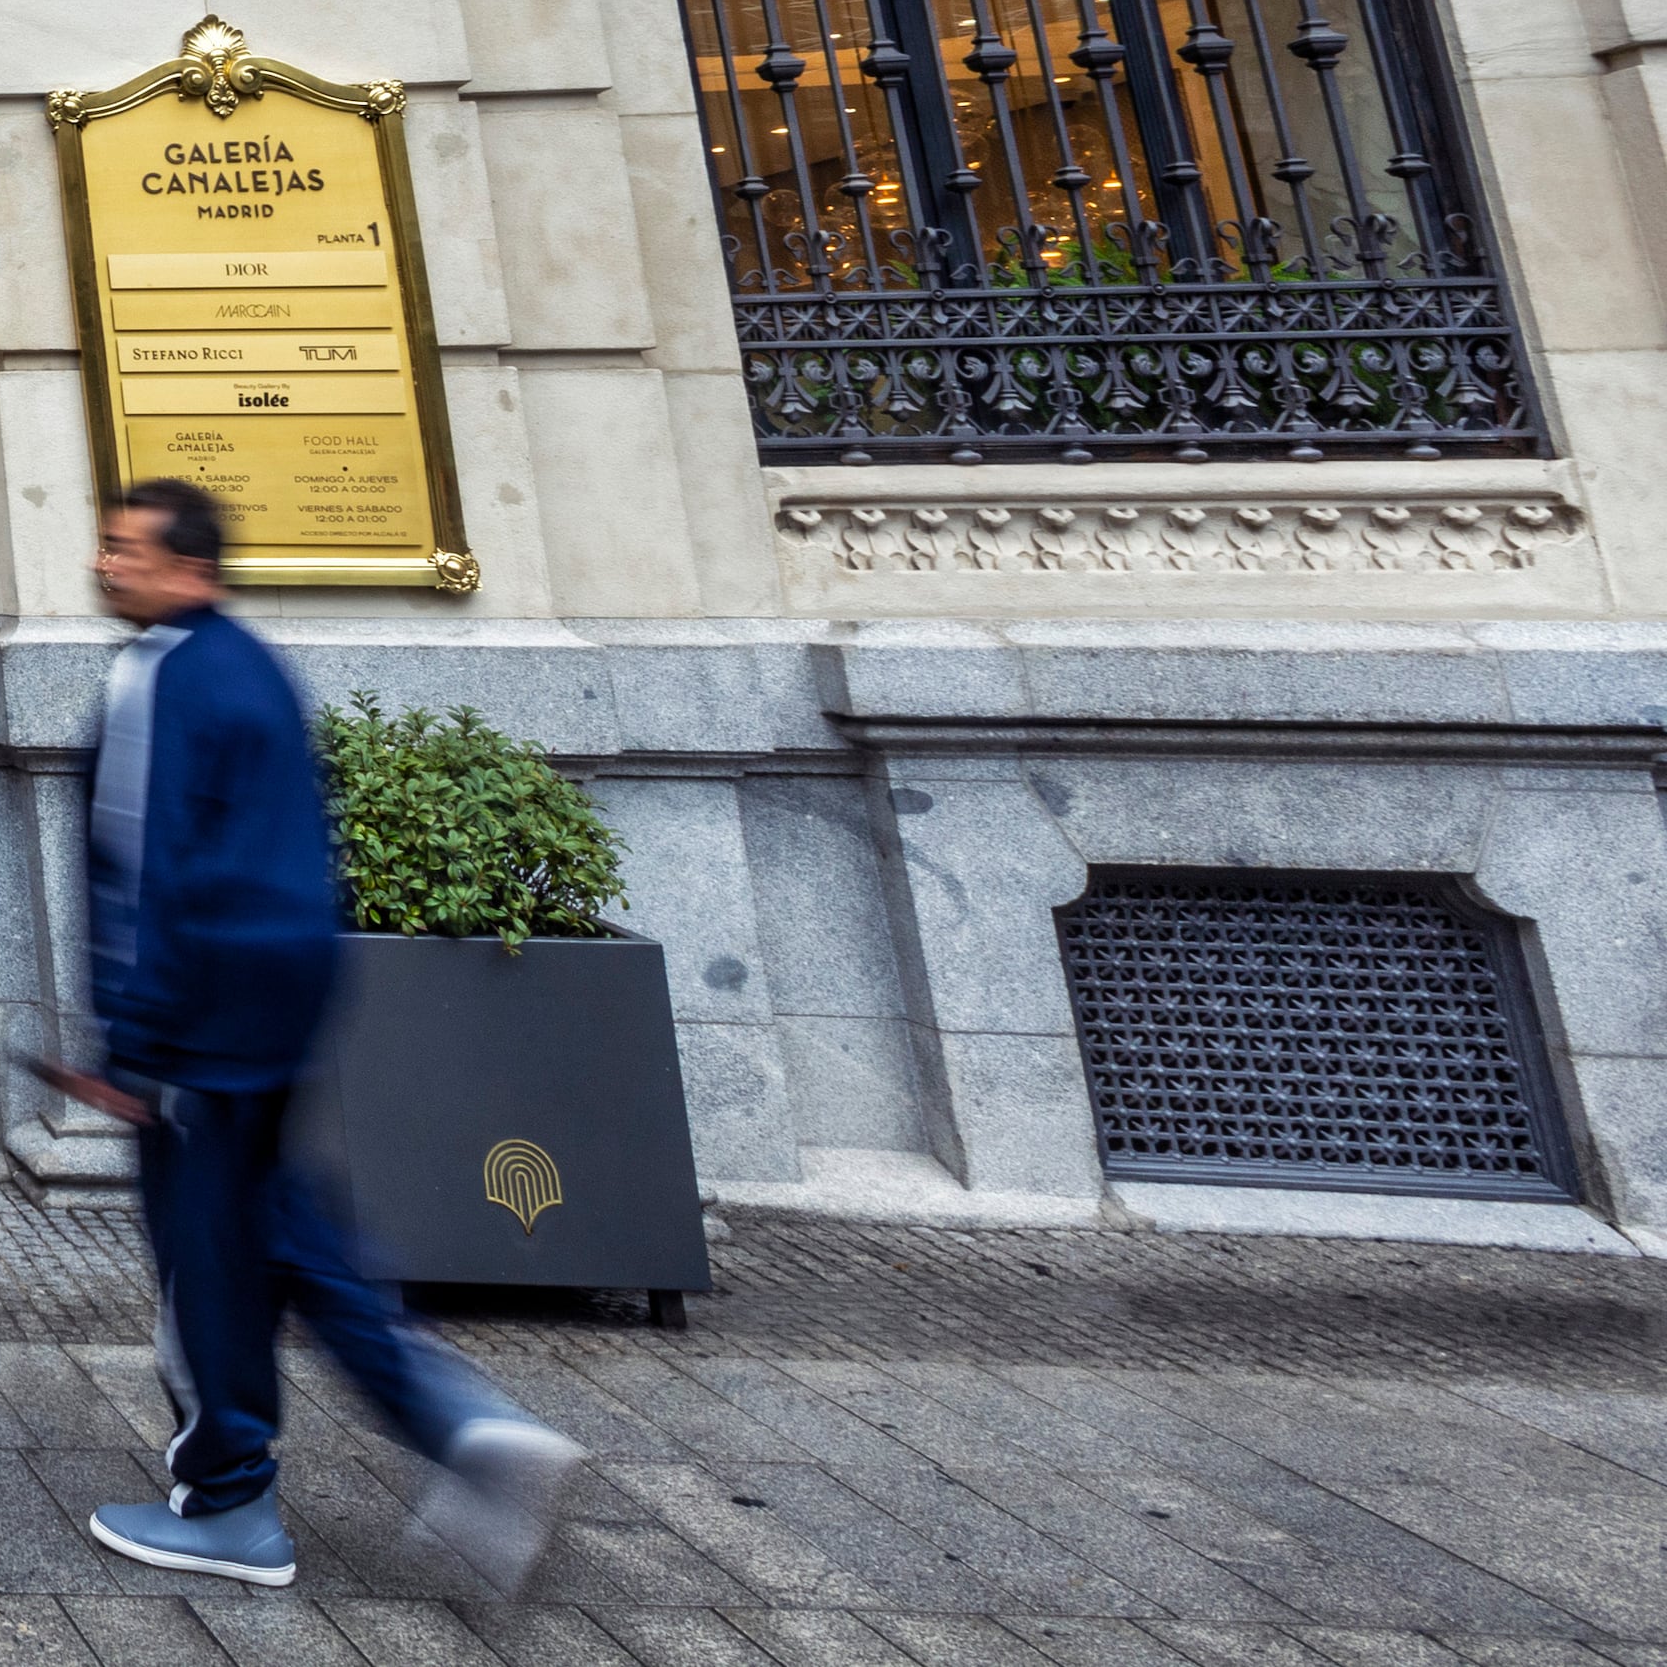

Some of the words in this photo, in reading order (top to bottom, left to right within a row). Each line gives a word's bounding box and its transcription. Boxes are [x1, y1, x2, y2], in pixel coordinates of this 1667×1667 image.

[164, 135, 294, 165] GALERÍA
[141, 168, 325, 196] CANALEJAS
[197, 203, 275, 219] MADRID
[317, 233, 365, 244] PLANTA
[367, 221, 381, 247] 1
[225, 262, 269, 277] DIOR
[299, 345, 358, 361] TUMI
[238, 392, 289, 407] isolée
[175, 430, 224, 441] GALERÍA
[303, 435, 342, 446] FOOD
[346, 435, 379, 446] HALL
[167, 443, 235, 453] CANALEJAS
[195, 474, 203, 483] A
[294, 475, 346, 484] DOMINGO
[348, 476, 356, 484] A
[358, 476, 399, 484] JUEVES
[211, 484, 244, 493] 20:30
[309, 485, 339, 494] 12:00
[341, 485, 349, 493] A
[351, 485, 387, 493] 00:00
[297, 505, 344, 513] VIERNES
[346, 505, 354, 513] A
[315, 515, 345, 523] 12:00
[347, 515, 355, 523] A
[357, 515, 388, 524] 01:00
